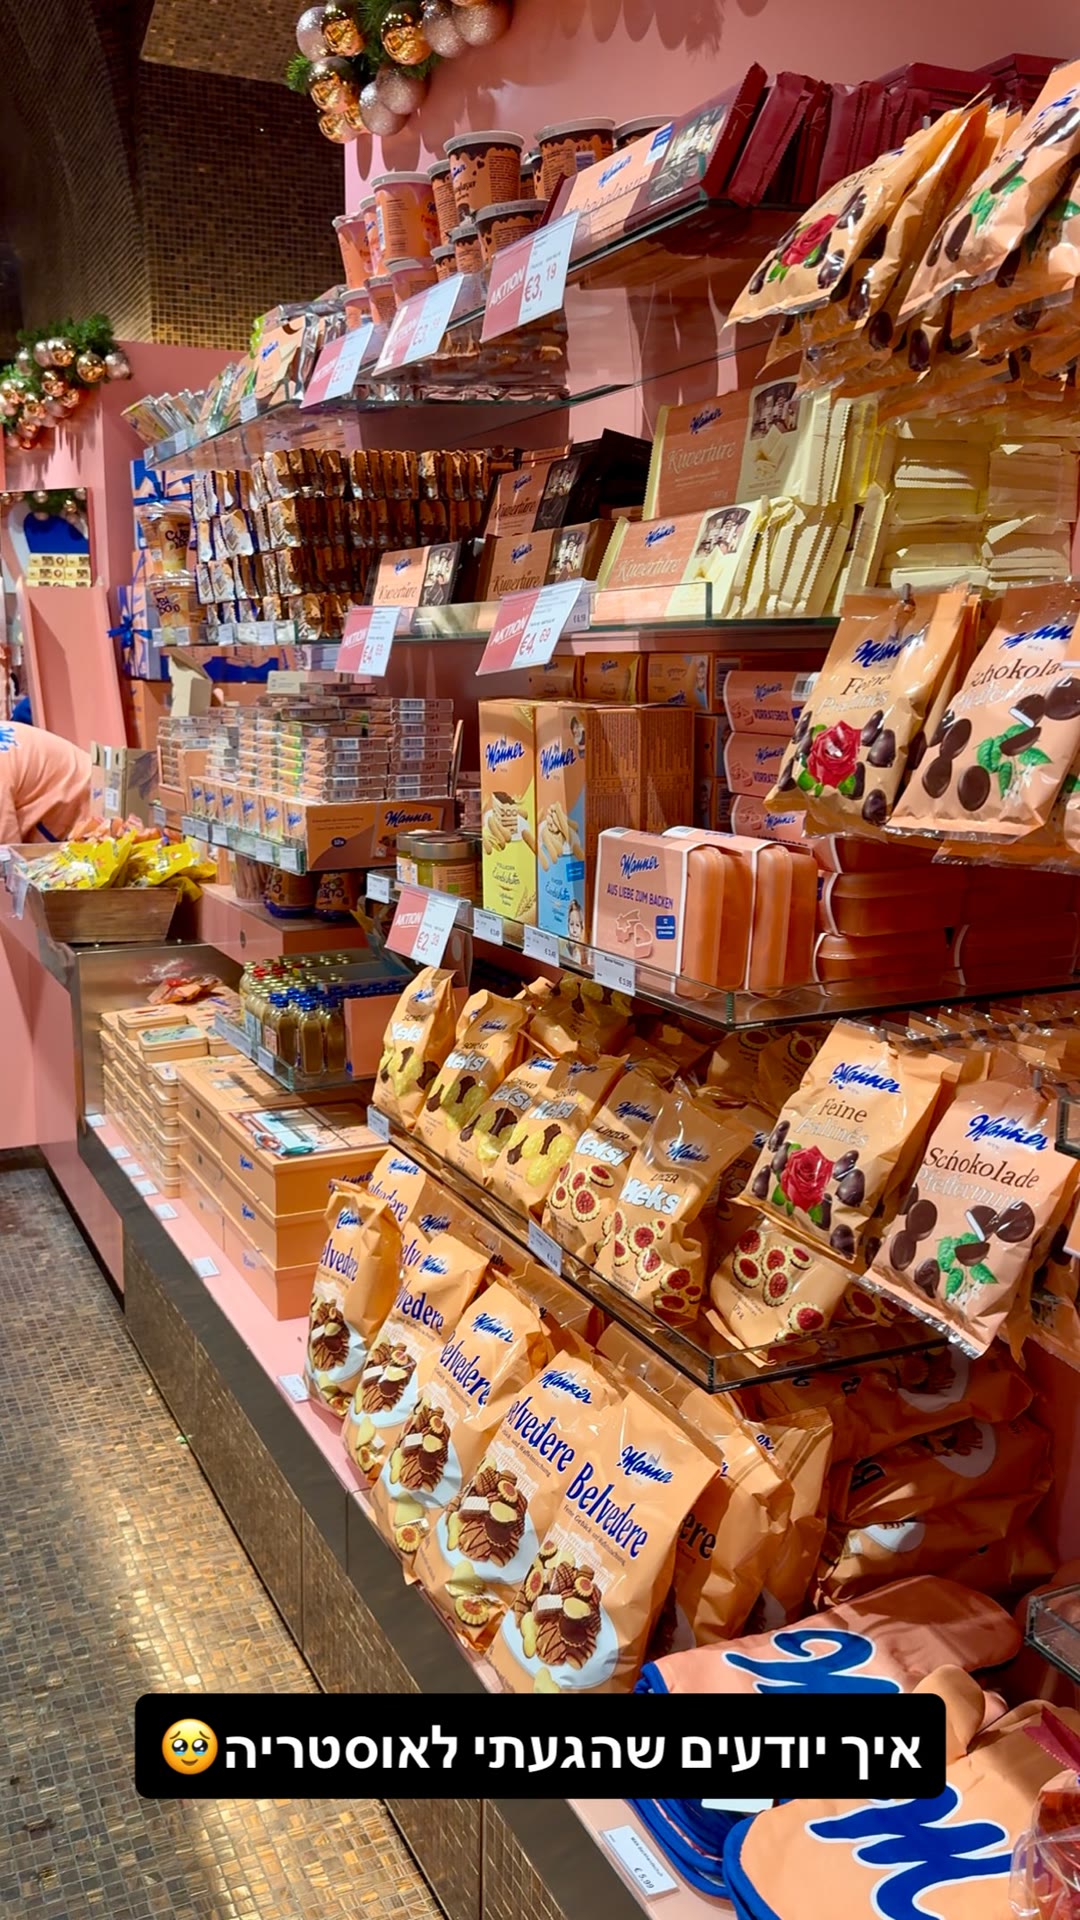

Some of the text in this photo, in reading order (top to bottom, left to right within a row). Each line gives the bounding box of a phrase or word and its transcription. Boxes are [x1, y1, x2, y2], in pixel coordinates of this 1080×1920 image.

[489, 265, 526, 309] AKTION
[690, 406, 724, 435] Manner
[645, 524, 677, 548] Manner
[489, 613, 530, 648] AKTION
[485, 740, 525, 774] Manner
[540, 744, 578, 780] Manner
[385, 810, 434, 828] Manner
[763, 812, 798, 833] Manner
[619, 852, 660, 880] Manner
[607, 882, 675, 910] AUS LIEBE ZUM BACKEN
[828, 1061, 901, 1095] Manner
[818, 1096, 868, 1126] Feine
[595, 1125, 630, 1142] LINZER
[963, 1113, 1050, 1154] Manner
[922, 1145, 1042, 1190] Schokolade
[320, 1237, 360, 1282] elvedere
[470, 1313, 514, 1344] Manner
[539, 1369, 593, 1405] Manner
[505, 1396, 577, 1475] elvedere
[617, 1444, 674, 1485] Manner
[564, 1460, 650, 1559] Belvedere
